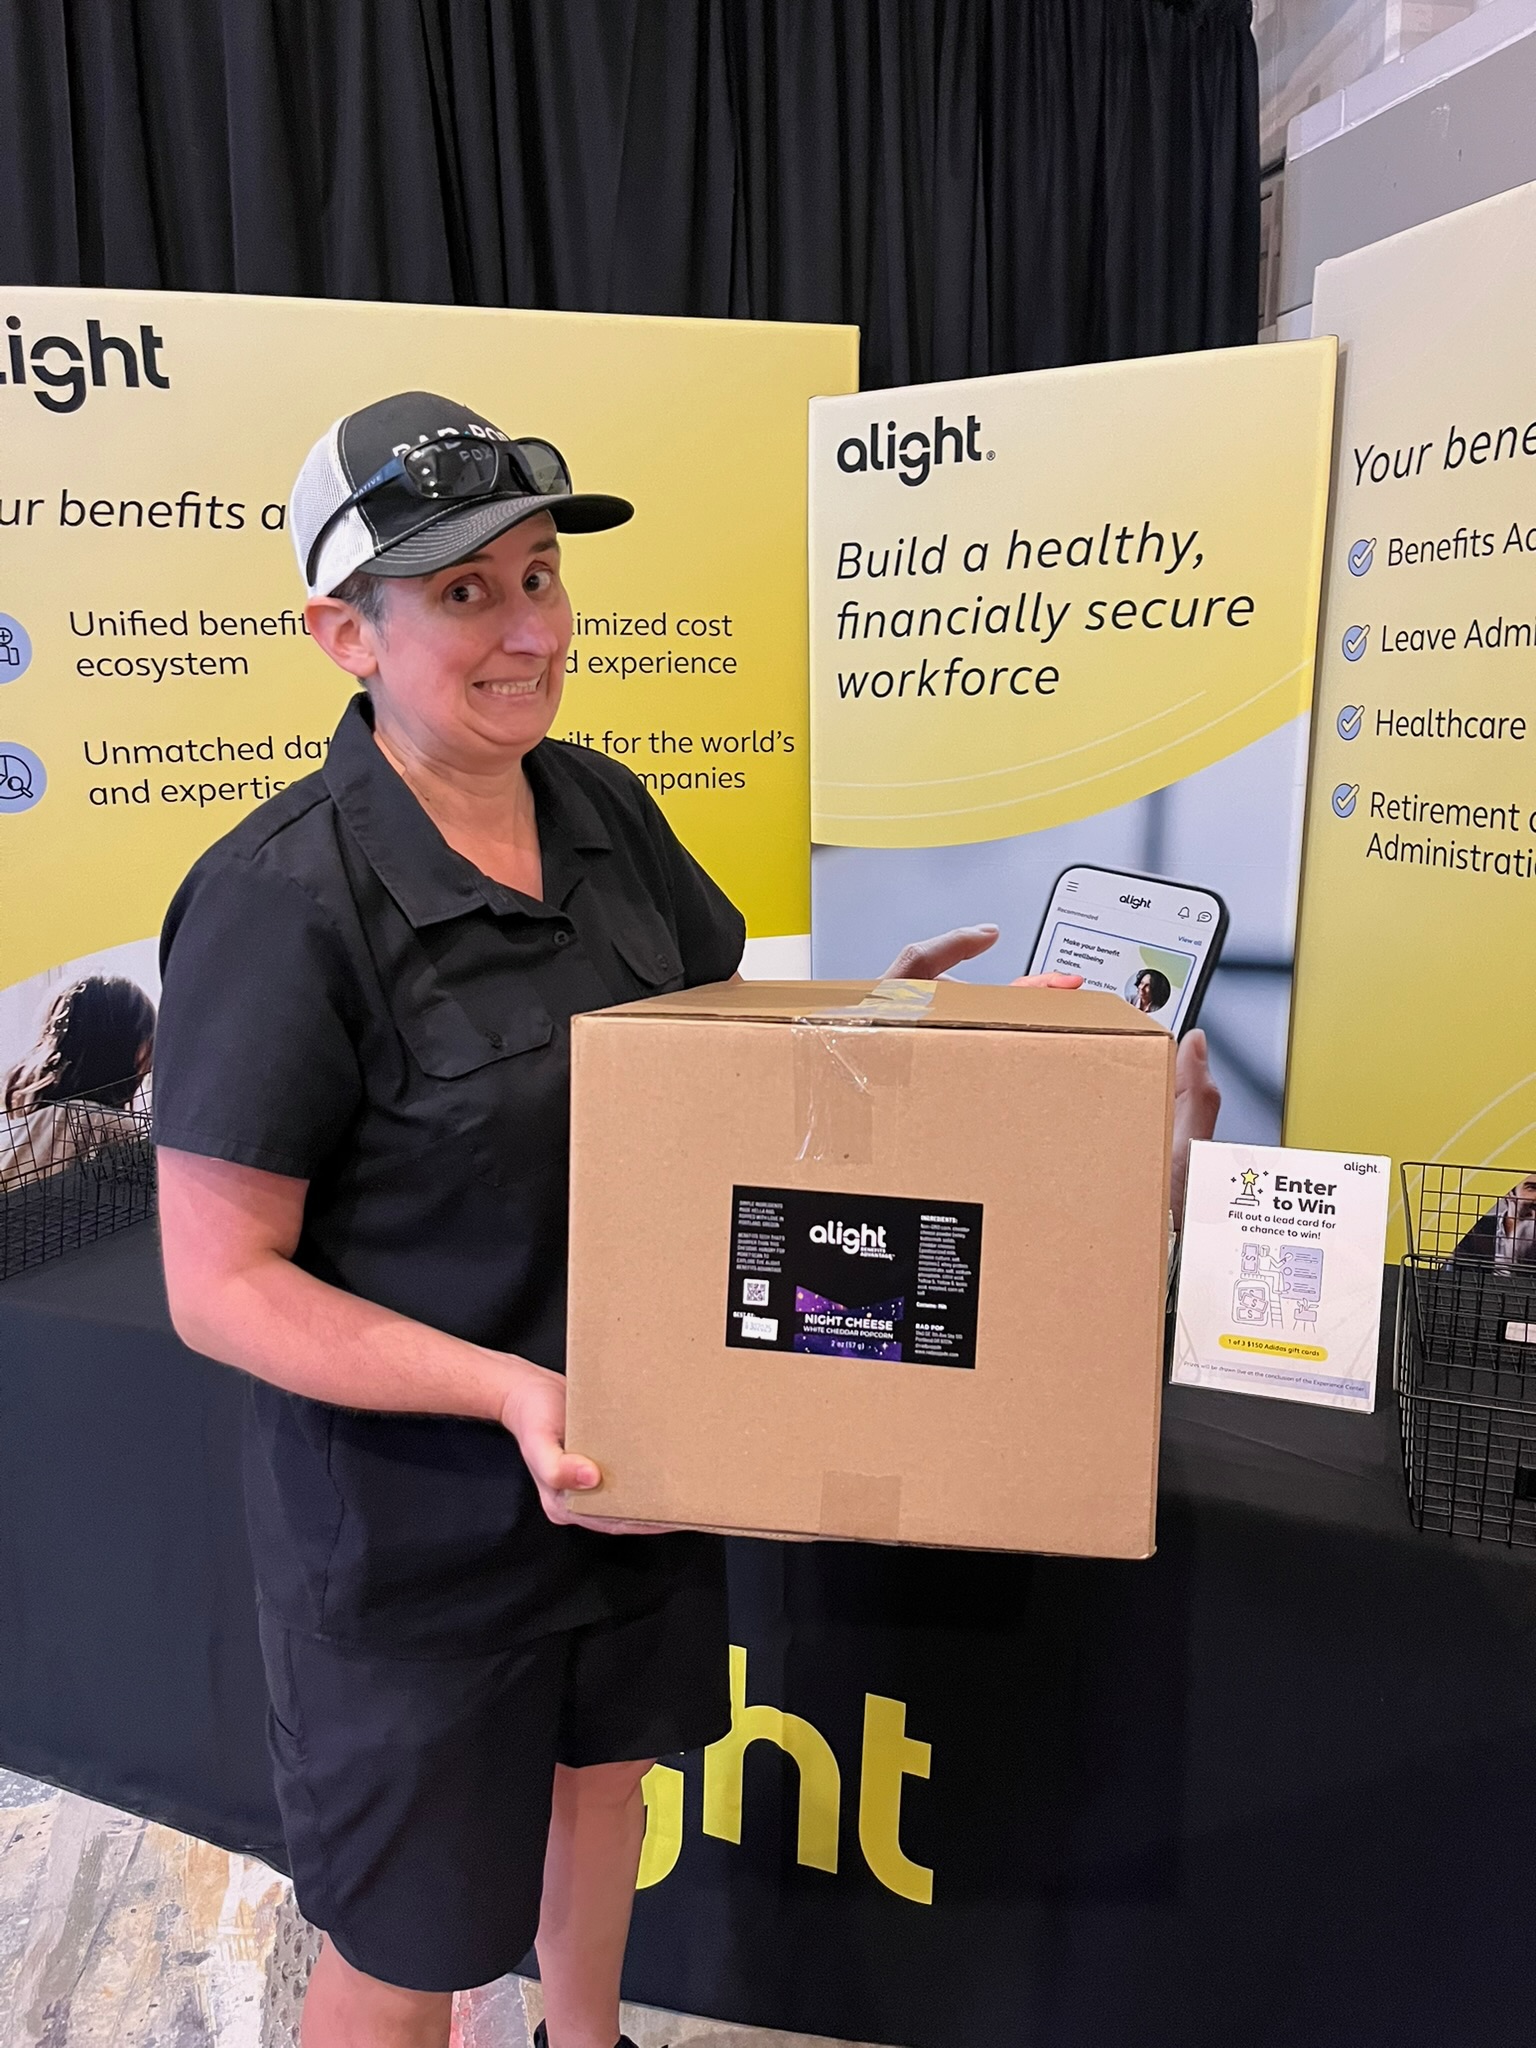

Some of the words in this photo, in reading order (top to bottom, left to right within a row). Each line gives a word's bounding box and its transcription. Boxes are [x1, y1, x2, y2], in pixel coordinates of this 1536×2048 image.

[0, 315, 170, 413] ight
[1354, 442, 1433, 486] Your
[1443, 421, 1536, 470] bene
[352, 475, 381, 500] NATIVE
[59, 488, 246, 530] benefits
[836, 534, 949, 580] Build
[963, 541, 989, 572] a
[1006, 520, 1205, 576] healthy,
[1388, 528, 1495, 567] Benefits
[69, 610, 188, 637] Unified
[572, 612, 667, 636] imized
[676, 615, 733, 637] cost
[837, 592, 1071, 644] financially
[1084, 594, 1256, 631] secure
[1381, 625, 1456, 652] Leave
[75, 652, 249, 683] ecosystem
[588, 651, 738, 680] experience
[837, 657, 1060, 699] workforce
[1376, 708, 1526, 740] Healthcare
[83, 735, 274, 765] Unmatched
[602, 730, 641, 754] for
[648, 730, 693, 754] the
[701, 730, 795, 753] world's
[89, 779, 150, 806] and
[160, 775, 296, 808] expertis
[1370, 791, 1520, 832] Retirement
[1366, 832, 1536, 878] Administrati
[1057, 907, 1099, 921] Recommended
[1119, 894, 1151, 909] alight
[1063, 937, 1081, 947] Make
[1081, 943, 1096, 951] your
[1096, 946, 1120, 957] benefit
[1178, 936, 1193, 944] View
[1060, 948, 1073, 956] and
[1073, 951, 1104, 965] wellbeing
[1087, 980, 1103, 988] ends
[1275, 1175, 1337, 1196] Enter
[1273, 1197, 1293, 1211] to
[1298, 1199, 1336, 1215] Win
[1228, 1210, 1243, 1220] Fill
[1245, 1214, 1262, 1222] out
[1273, 1214, 1295, 1225] lead
[1297, 1218, 1319, 1228] card
[1322, 1220, 1336, 1229] for
[1249, 1225, 1285, 1236] chance
[1287, 1229, 1298, 1237] to
[1300, 1231, 1321, 1240] win!
[809, 1220, 887, 1255] alight
[804, 1314, 843, 1326] NIGHT
[844, 1317, 893, 1331] CHEESE
[826, 1327, 859, 1336] CHEDDAR
[860, 1330, 893, 1339] POPCORN
[1264, 1344, 1287, 1352] Adidas
[1265, 1373, 1294, 1381] conclusion
[1313, 1380, 1344, 1389] Experience
